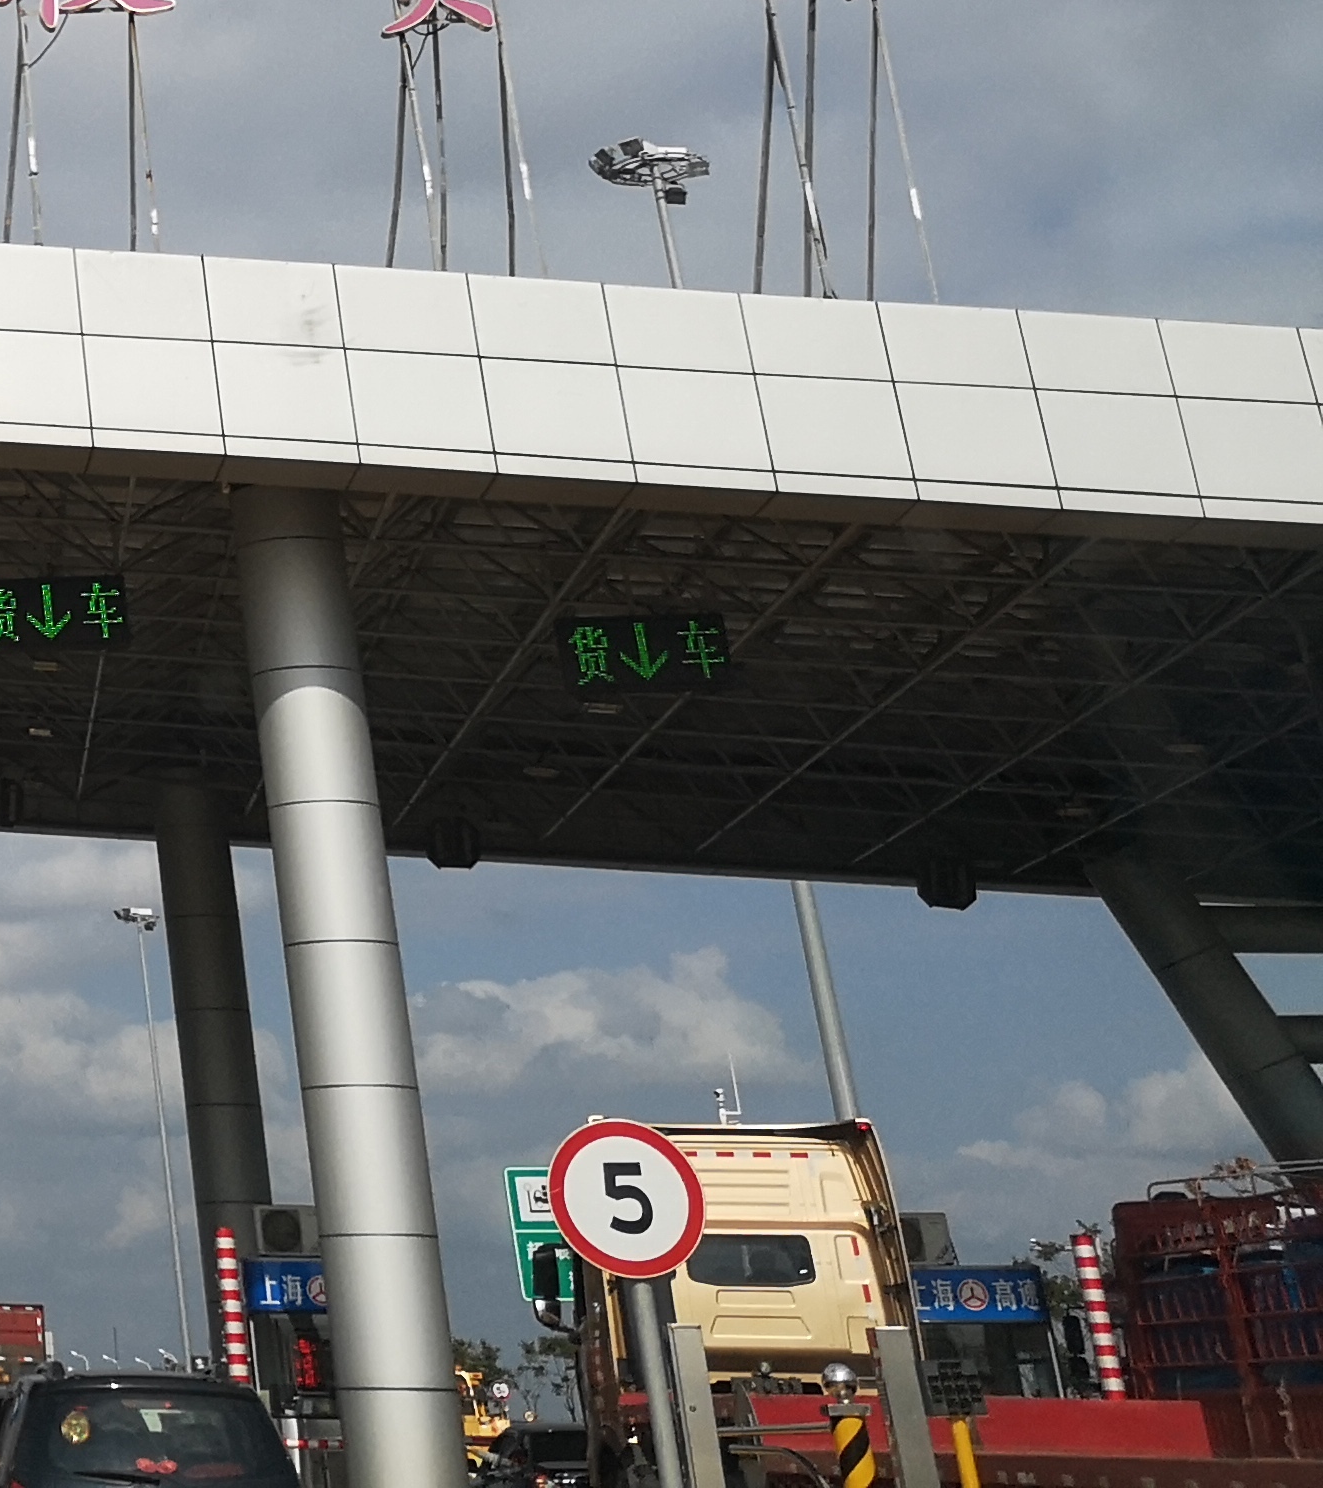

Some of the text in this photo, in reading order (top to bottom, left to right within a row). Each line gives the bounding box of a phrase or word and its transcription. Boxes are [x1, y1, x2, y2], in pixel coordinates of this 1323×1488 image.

[602, 1161, 654, 1236] 5
[259, 1274, 304, 1306] 上海
[991, 1278, 1041, 1311] 高速
